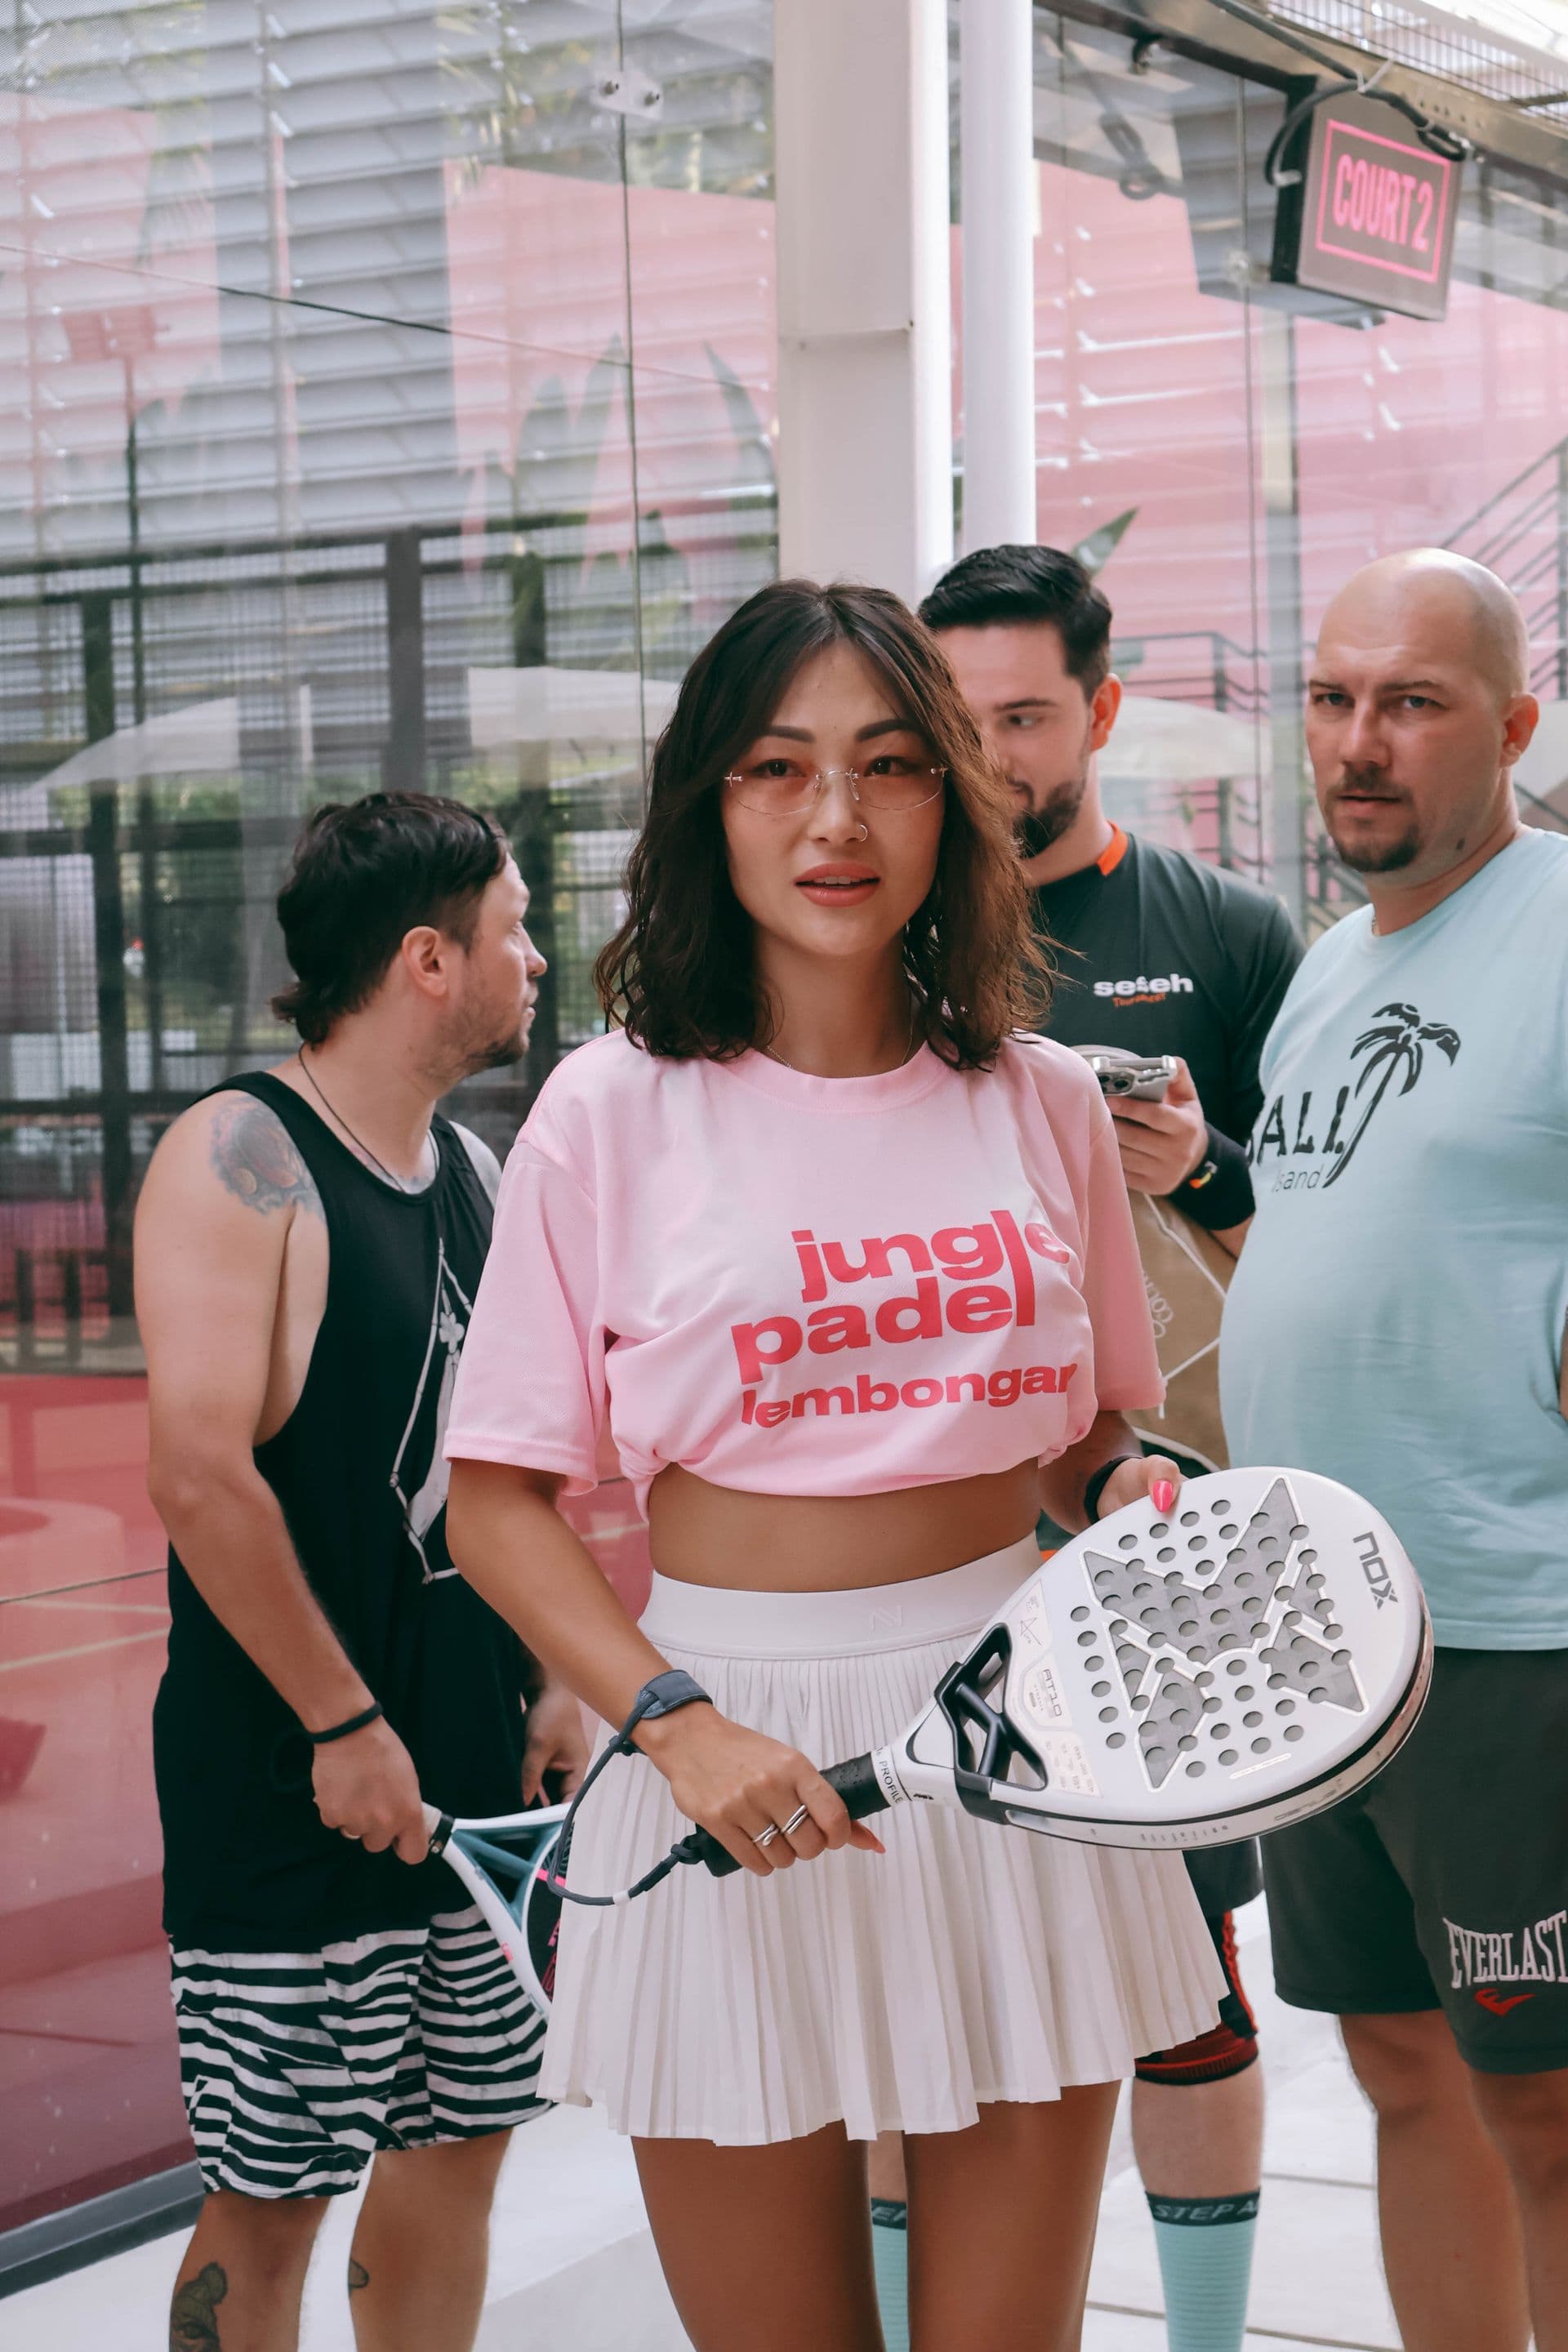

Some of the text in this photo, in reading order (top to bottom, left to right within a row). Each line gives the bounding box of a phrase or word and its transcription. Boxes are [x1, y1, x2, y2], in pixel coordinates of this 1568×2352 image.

[1332, 154, 1434, 252] COURT 2
[1247, 1085, 1349, 1167] ALI
[791, 1209, 1070, 1321] jungle
[731, 1272, 1036, 1386] padel
[879, 1760, 904, 1804] PROFILE
[1442, 1909, 1568, 1989] EVERLAST
[1154, 2203, 1235, 2221] STEP
